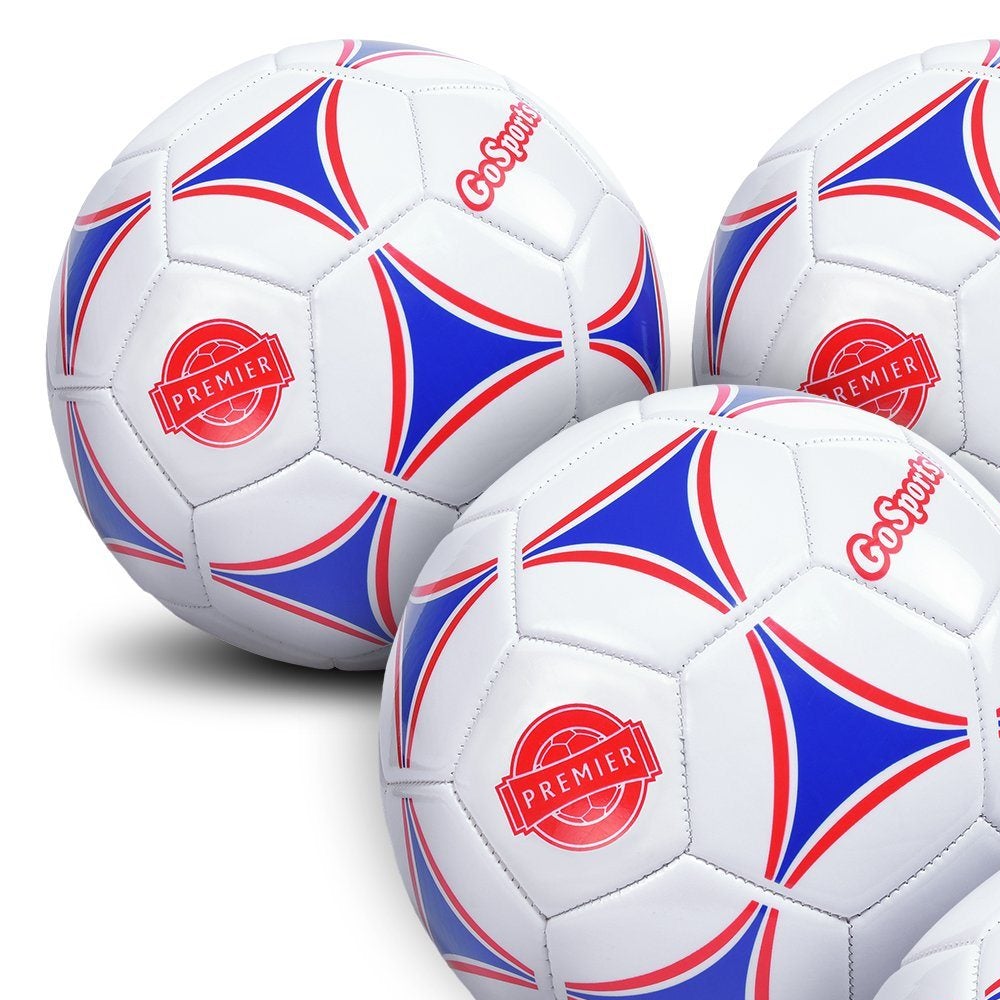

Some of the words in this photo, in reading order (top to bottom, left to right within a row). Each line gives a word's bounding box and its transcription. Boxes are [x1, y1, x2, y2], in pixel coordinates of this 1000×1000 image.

[455, 101, 541, 213] GoSports
[171, 356, 272, 412] PREMIER
[846, 455, 944, 582] GoSports
[521, 746, 637, 810] PREMIER
